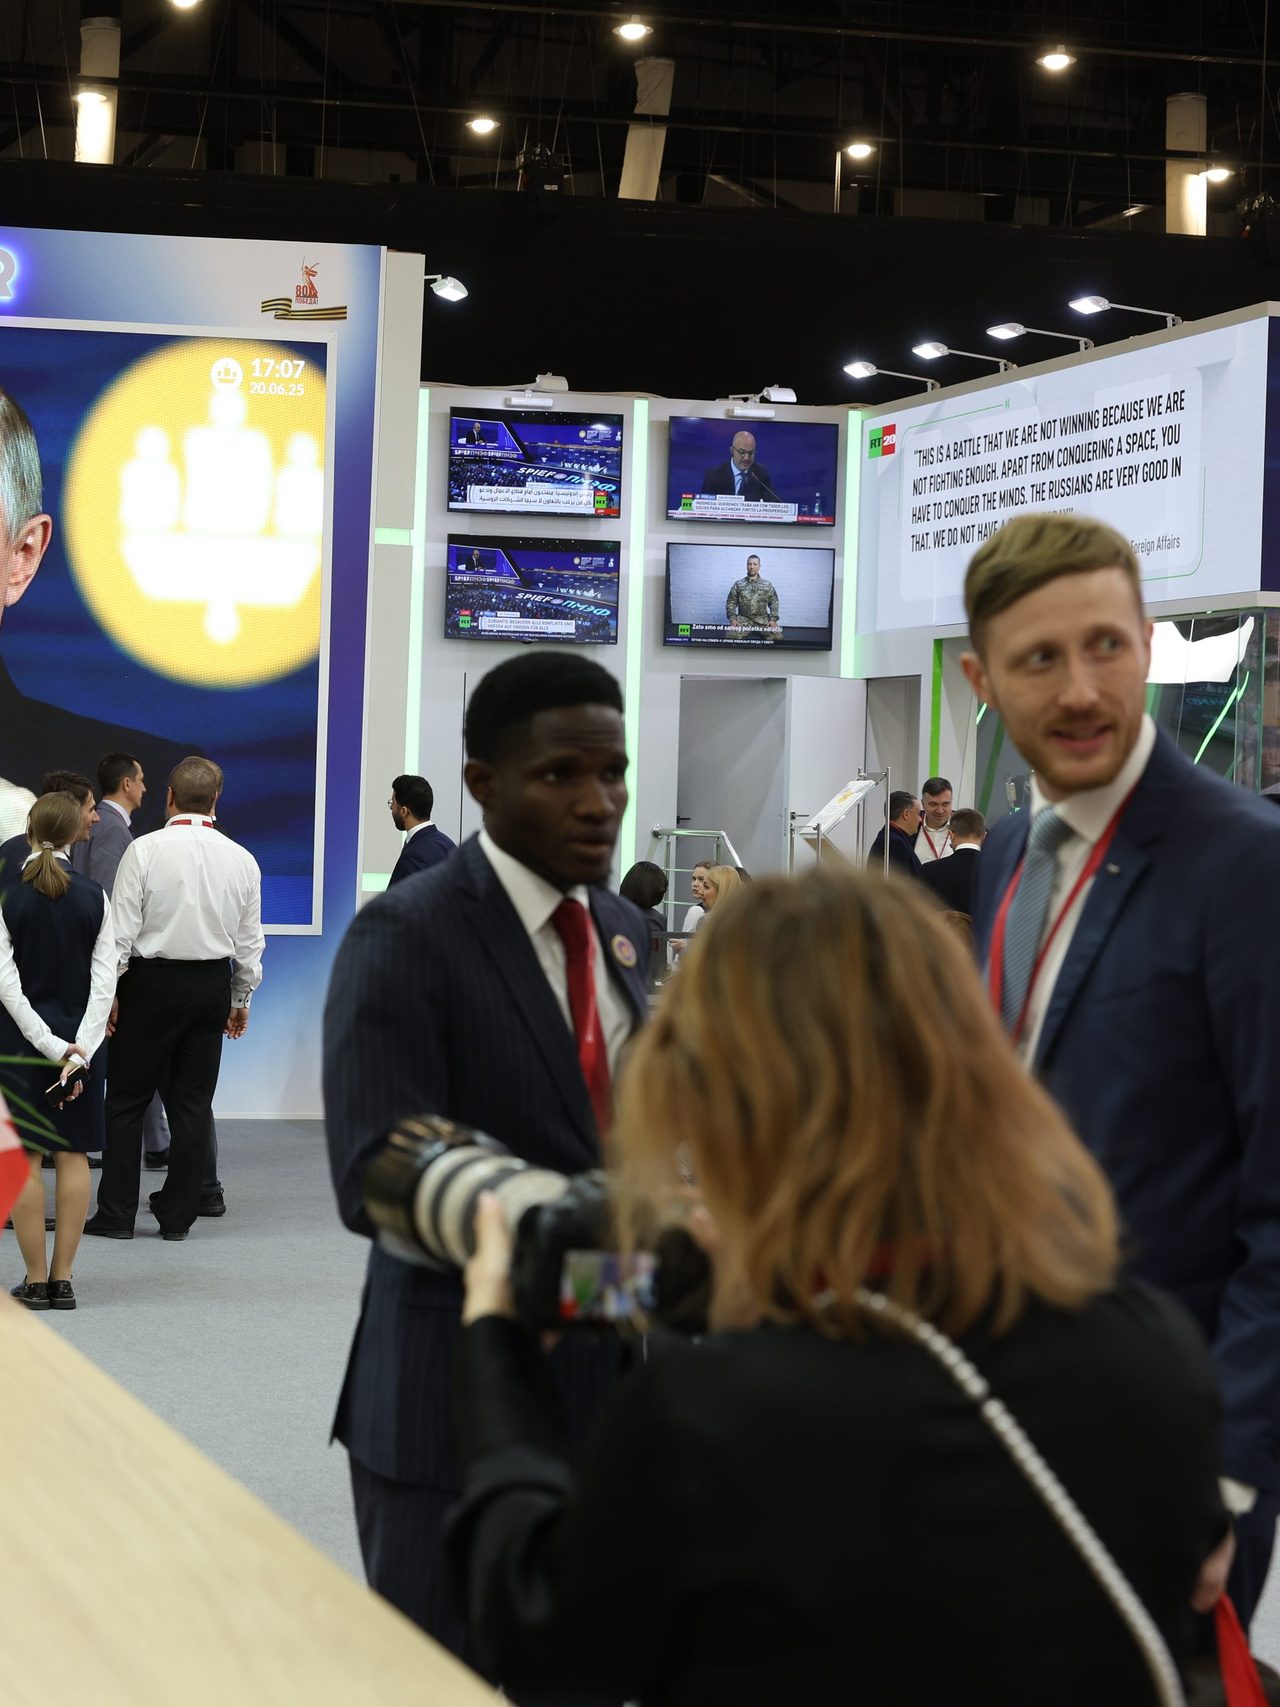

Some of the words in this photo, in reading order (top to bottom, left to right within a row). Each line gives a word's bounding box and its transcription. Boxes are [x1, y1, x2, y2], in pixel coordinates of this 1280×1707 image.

[295, 285, 309, 297] 80
[295, 297, 318, 305] ПОБЕДА!
[251, 359, 306, 379] 17:07
[250, 382, 305, 396] 20.06.25
[936, 443, 944, 464] IS
[945, 442, 952, 462] A
[953, 436, 981, 460] BATTLE
[984, 431, 1004, 455] THAT
[1005, 427, 1019, 451] WE
[1020, 424, 1038, 447] ARE
[1040, 419, 1057, 441] NOT
[1059, 409, 1100, 437] WINNING
[1102, 399, 1144, 428] BECAUSE
[1147, 395, 1163, 418] WE
[1165, 390, 1186, 414] ARE
[913, 476, 928, 497] NOT
[929, 469, 963, 494] FIGHTING
[965, 462, 999, 486] ENOUGH.
[1001, 456, 1029, 479] APART
[1030, 450, 1055, 473] FROM
[1057, 438, 1114, 468] CONQUERING
[1116, 436, 1123, 456] A
[1126, 429, 1159, 454] SPACE,
[1162, 424, 1181, 447] YOU
[517, 467, 556, 480] SPIEF
[565, 474, 617, 492] ПМЭФ
[912, 504, 931, 524] HAVE
[933, 502, 942, 520] TO
[944, 495, 980, 518] CONQUER
[982, 491, 997, 512] THE
[998, 486, 1028, 509] MINDS.
[1030, 482, 1046, 503] THE
[1048, 473, 1093, 500] RUSSIANS
[1095, 469, 1114, 492] ARE
[1116, 464, 1140, 488] VERY
[1142, 459, 1168, 483] GOOD
[1171, 456, 1182, 478] IN
[911, 532, 931, 552] THAT.
[933, 530, 946, 548] WE
[947, 527, 958, 546] DO
[960, 524, 976, 544] NOT
[977, 520, 998, 541] HAVE
[1131, 538, 1155, 556] Foreign
[1156, 534, 1181, 551] Affairs
[515, 592, 553, 603] SPIEF
[562, 600, 611, 616] ПМЭФ
